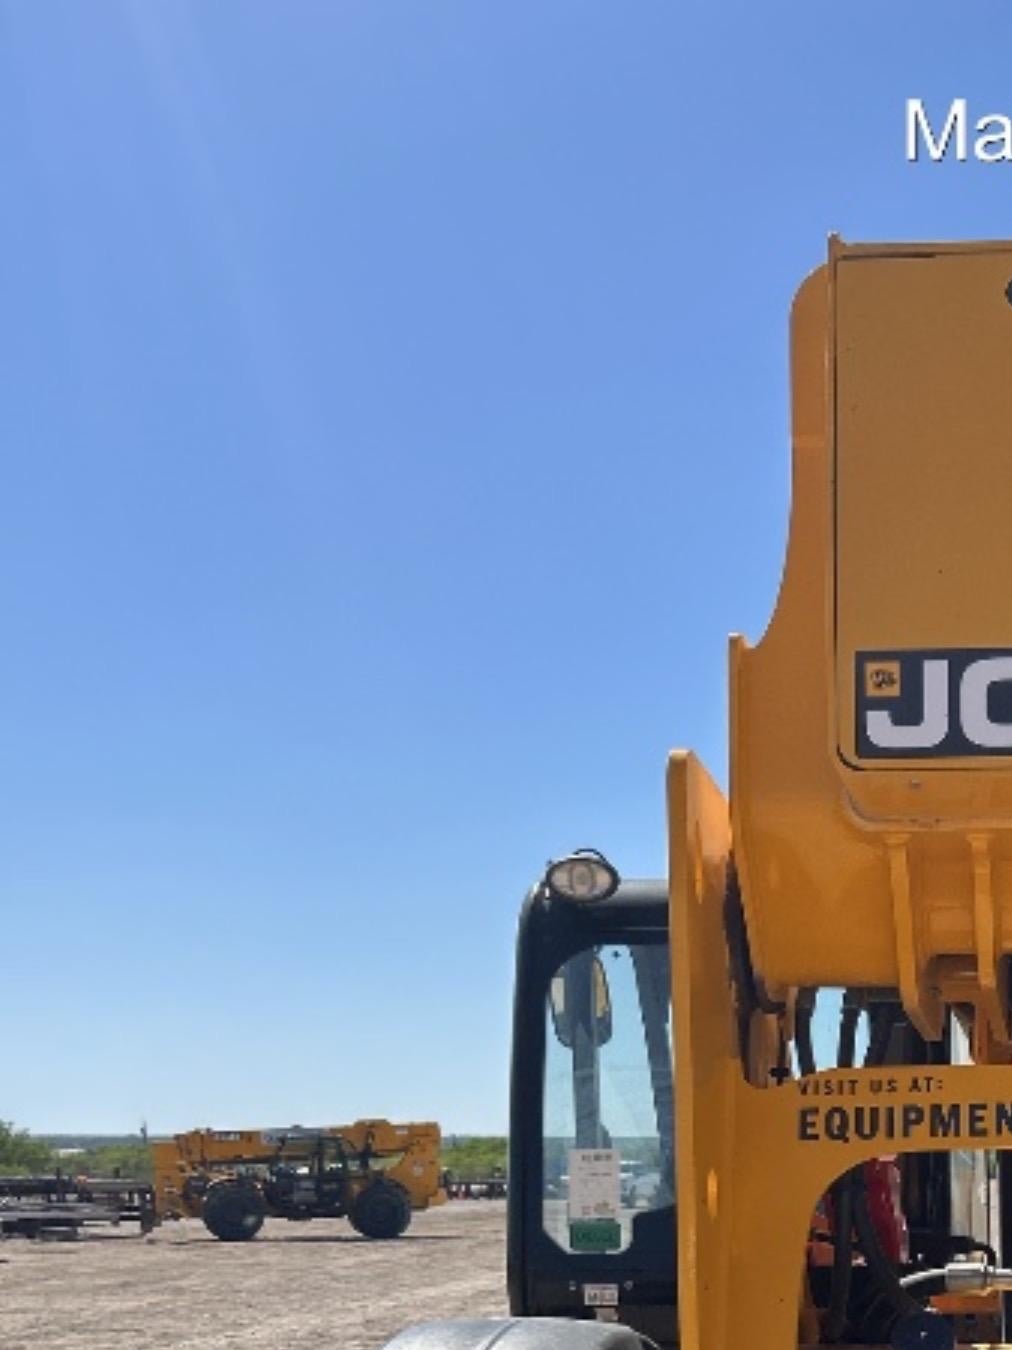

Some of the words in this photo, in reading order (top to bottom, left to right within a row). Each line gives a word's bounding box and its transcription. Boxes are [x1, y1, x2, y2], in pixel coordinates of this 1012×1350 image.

[798, 1080, 858, 1096] VISIT
[870, 1079, 897, 1094] US
[909, 1076, 943, 1093] AT:
